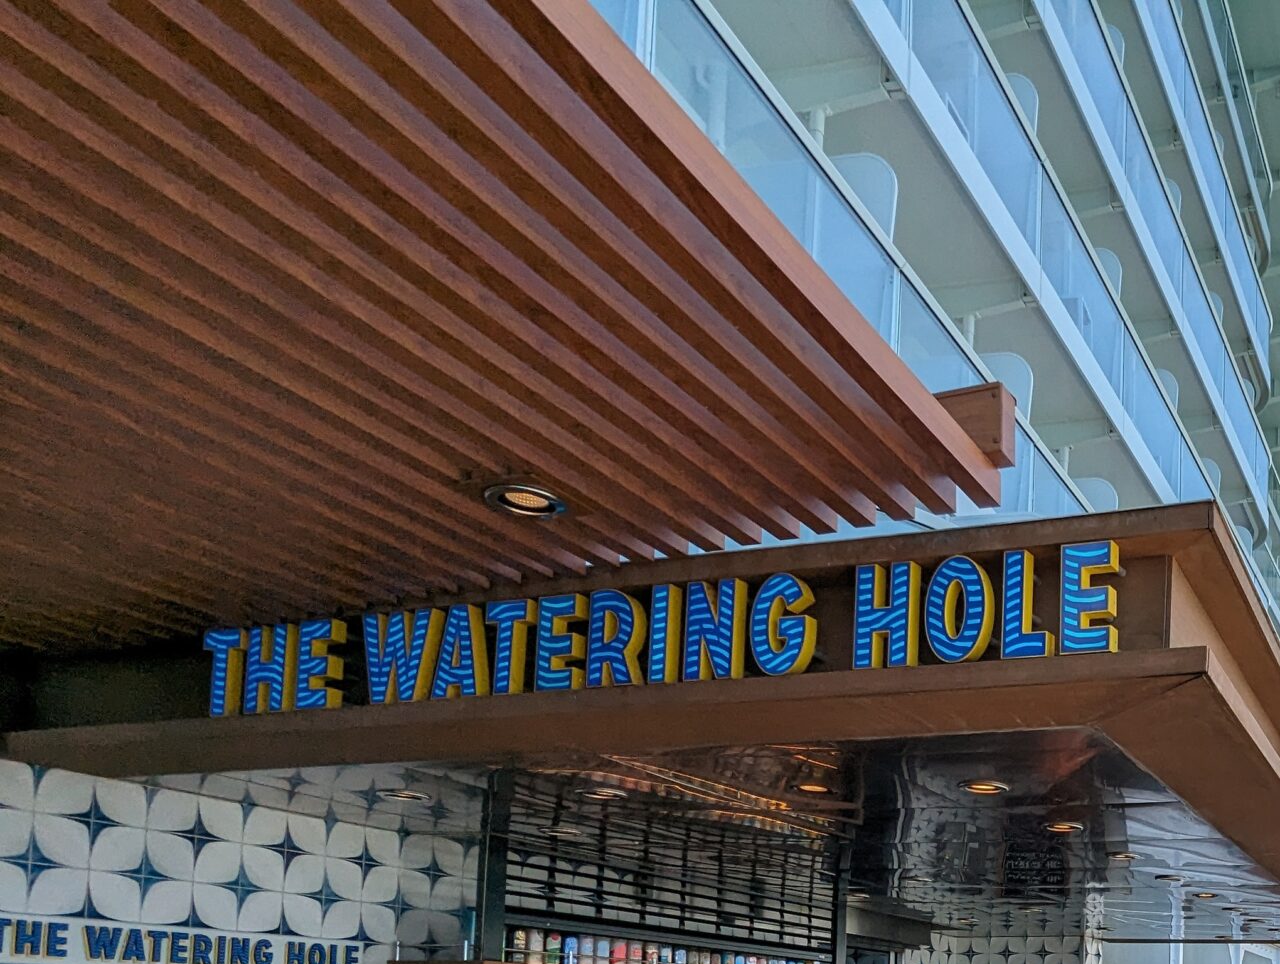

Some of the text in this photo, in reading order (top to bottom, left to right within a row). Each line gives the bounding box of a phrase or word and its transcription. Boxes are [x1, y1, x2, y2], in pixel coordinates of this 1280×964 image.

[203, 540, 1120, 717] THE WATERING HOLE
